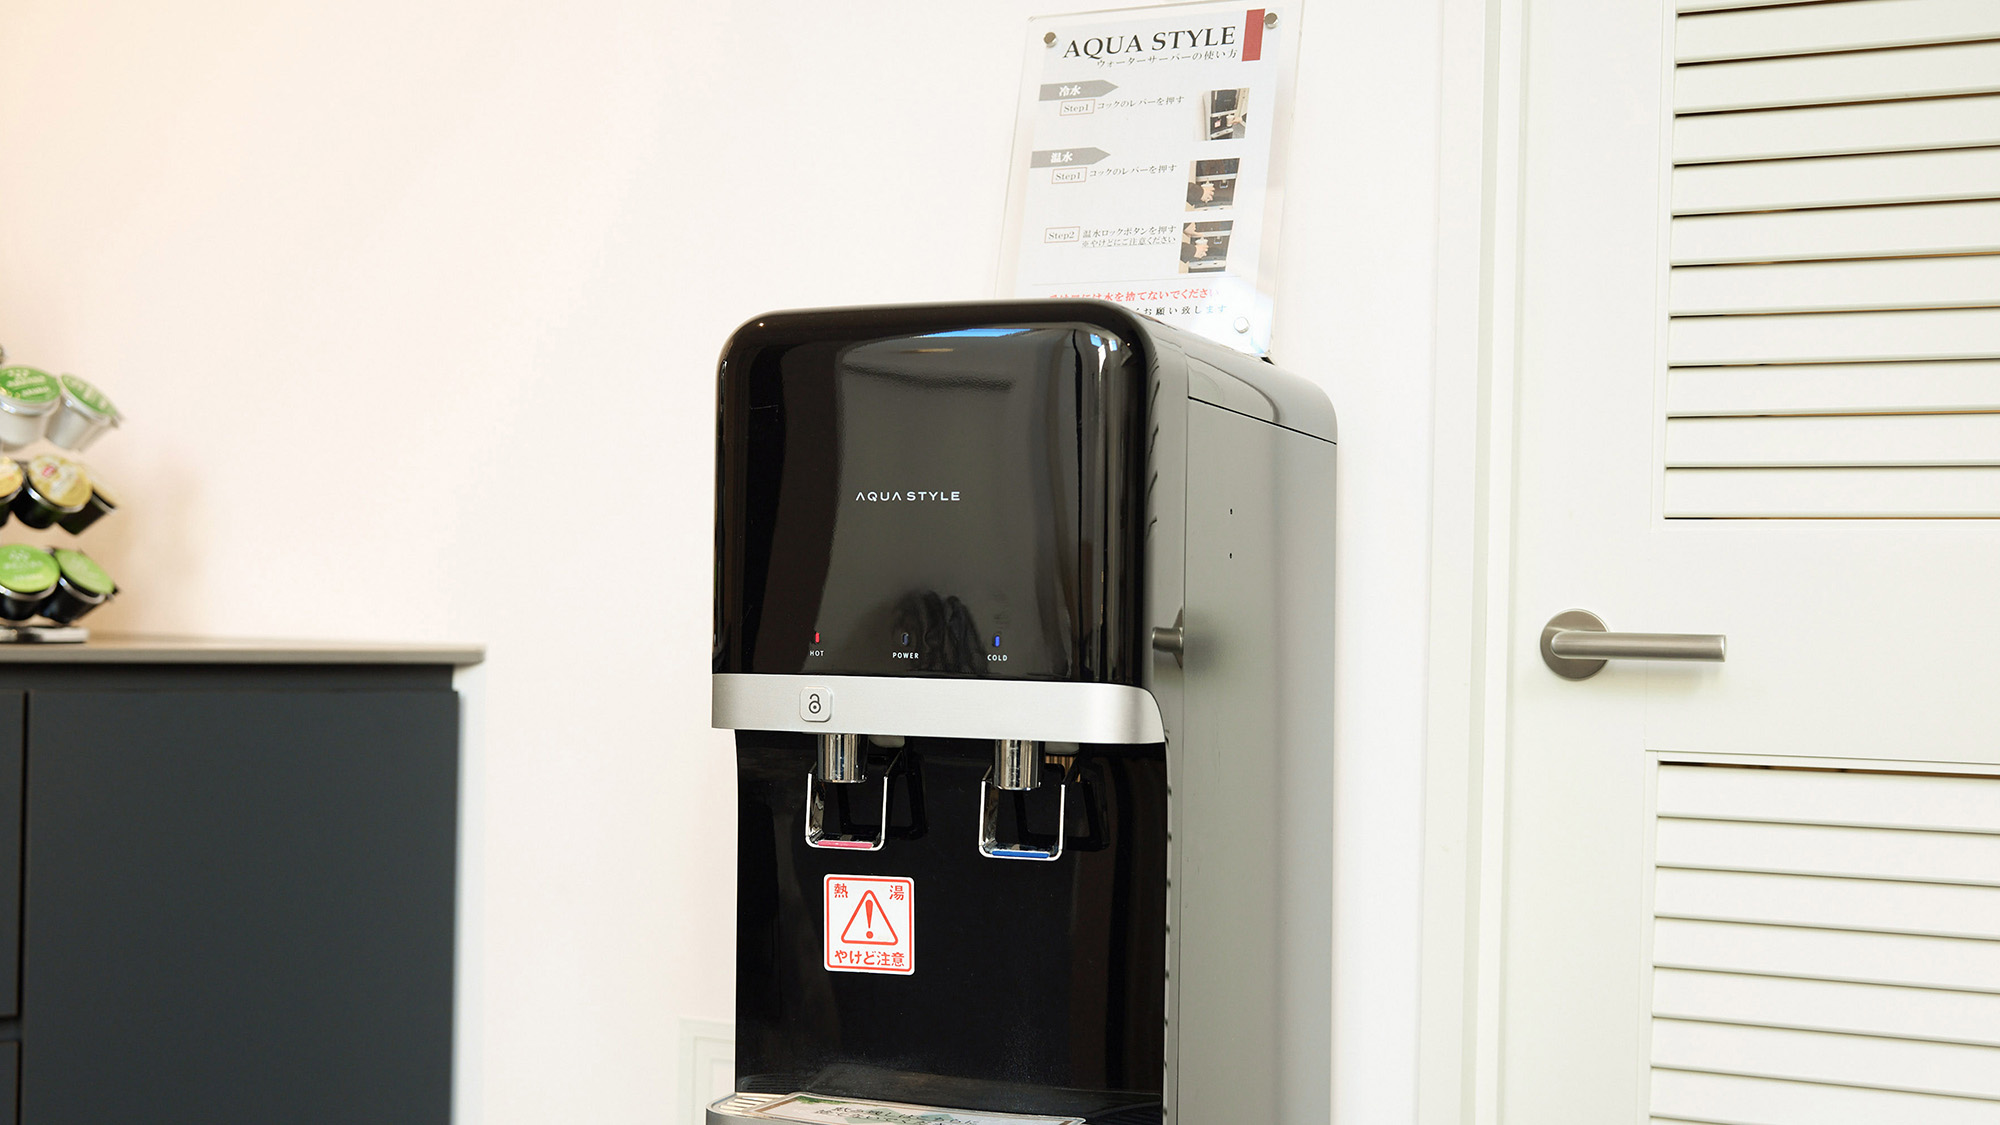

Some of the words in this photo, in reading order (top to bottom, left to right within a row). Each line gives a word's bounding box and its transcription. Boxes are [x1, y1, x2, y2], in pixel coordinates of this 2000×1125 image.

[1063, 35, 1143, 59] AQUA
[1151, 26, 1237, 51] STYLE
[1097, 48, 1238, 68] ウォーターサーバーの使い方
[1058, 84, 1082, 97] 冷水
[1063, 103, 1090, 114] Step1
[1096, 95, 1185, 110] コックのレバーを押す
[1050, 151, 1074, 164] 温水
[1055, 171, 1082, 182] Step1
[1089, 164, 1178, 178] コックのレバーを押す
[1048, 230, 1075, 242] Step2
[855, 491, 902, 502] AQUA
[906, 491, 961, 502] STYLE
[809, 649, 825, 658] HOT
[892, 651, 919, 660] POWER
[987, 653, 1008, 662] COLD
[834, 883, 849, 899] 熱
[889, 884, 905, 901] 湯
[834, 949, 905, 967] やけど注意
